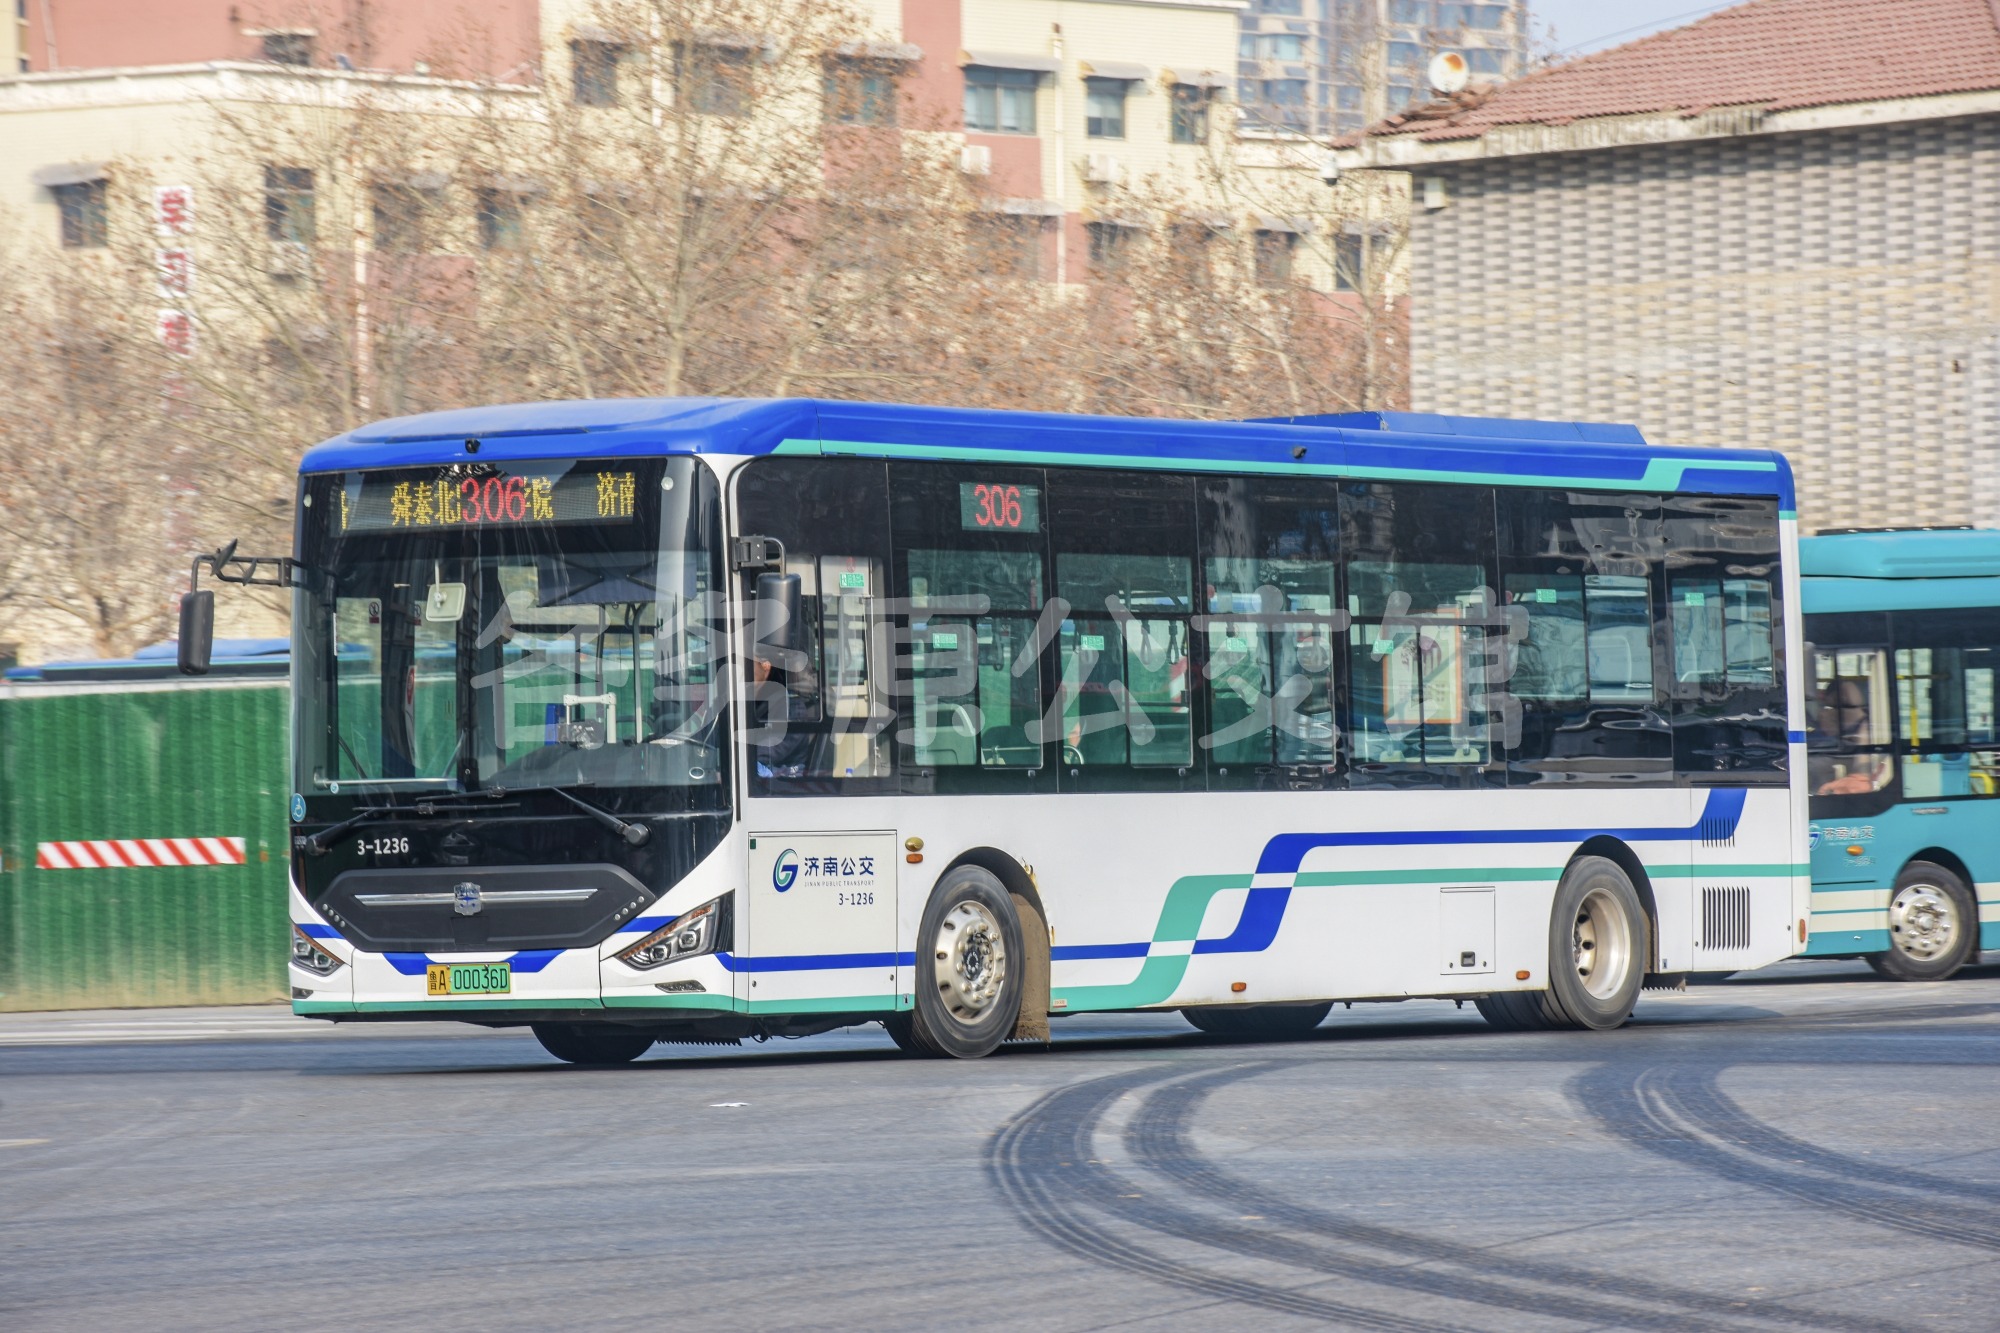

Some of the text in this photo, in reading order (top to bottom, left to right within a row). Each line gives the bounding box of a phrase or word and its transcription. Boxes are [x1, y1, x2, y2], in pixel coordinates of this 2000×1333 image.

[391, 480, 461, 526] 舜泰北
[461, 476, 526, 523] 306
[597, 471, 635, 517] 济南
[974, 484, 1022, 527] 306
[357, 837, 409, 855] 3-1236
[804, 856, 874, 877] 济南公交
[838, 892, 874, 905] 3-1236
